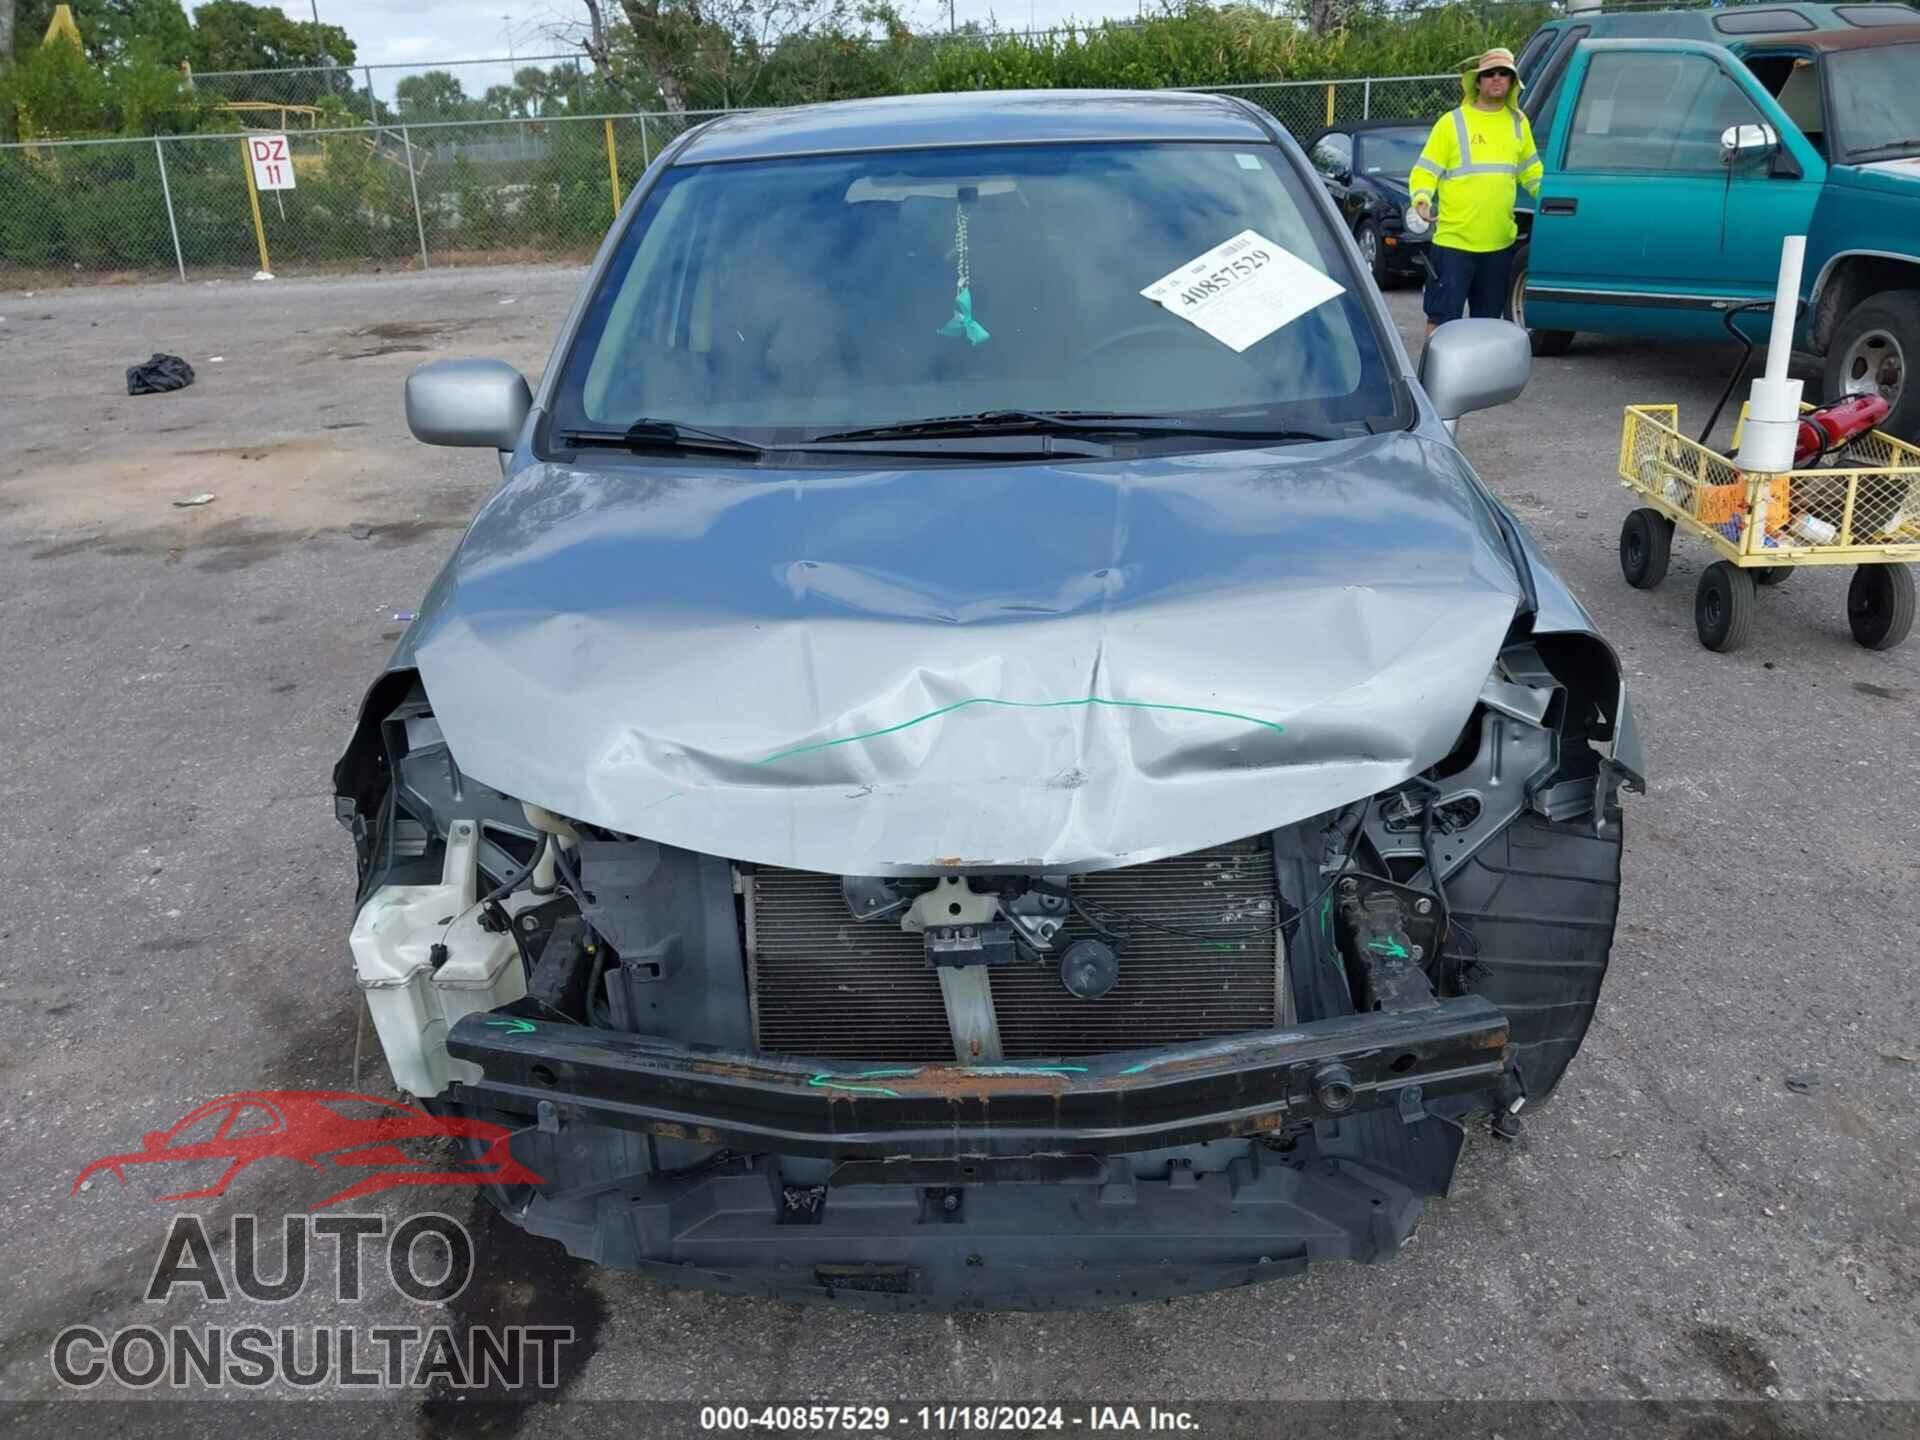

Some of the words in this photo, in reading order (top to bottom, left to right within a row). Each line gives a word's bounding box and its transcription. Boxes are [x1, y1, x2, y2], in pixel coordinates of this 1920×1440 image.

[253, 140, 287, 161] DZ
[266, 165, 281, 184] 11
[1180, 249, 1272, 307] 40857529
